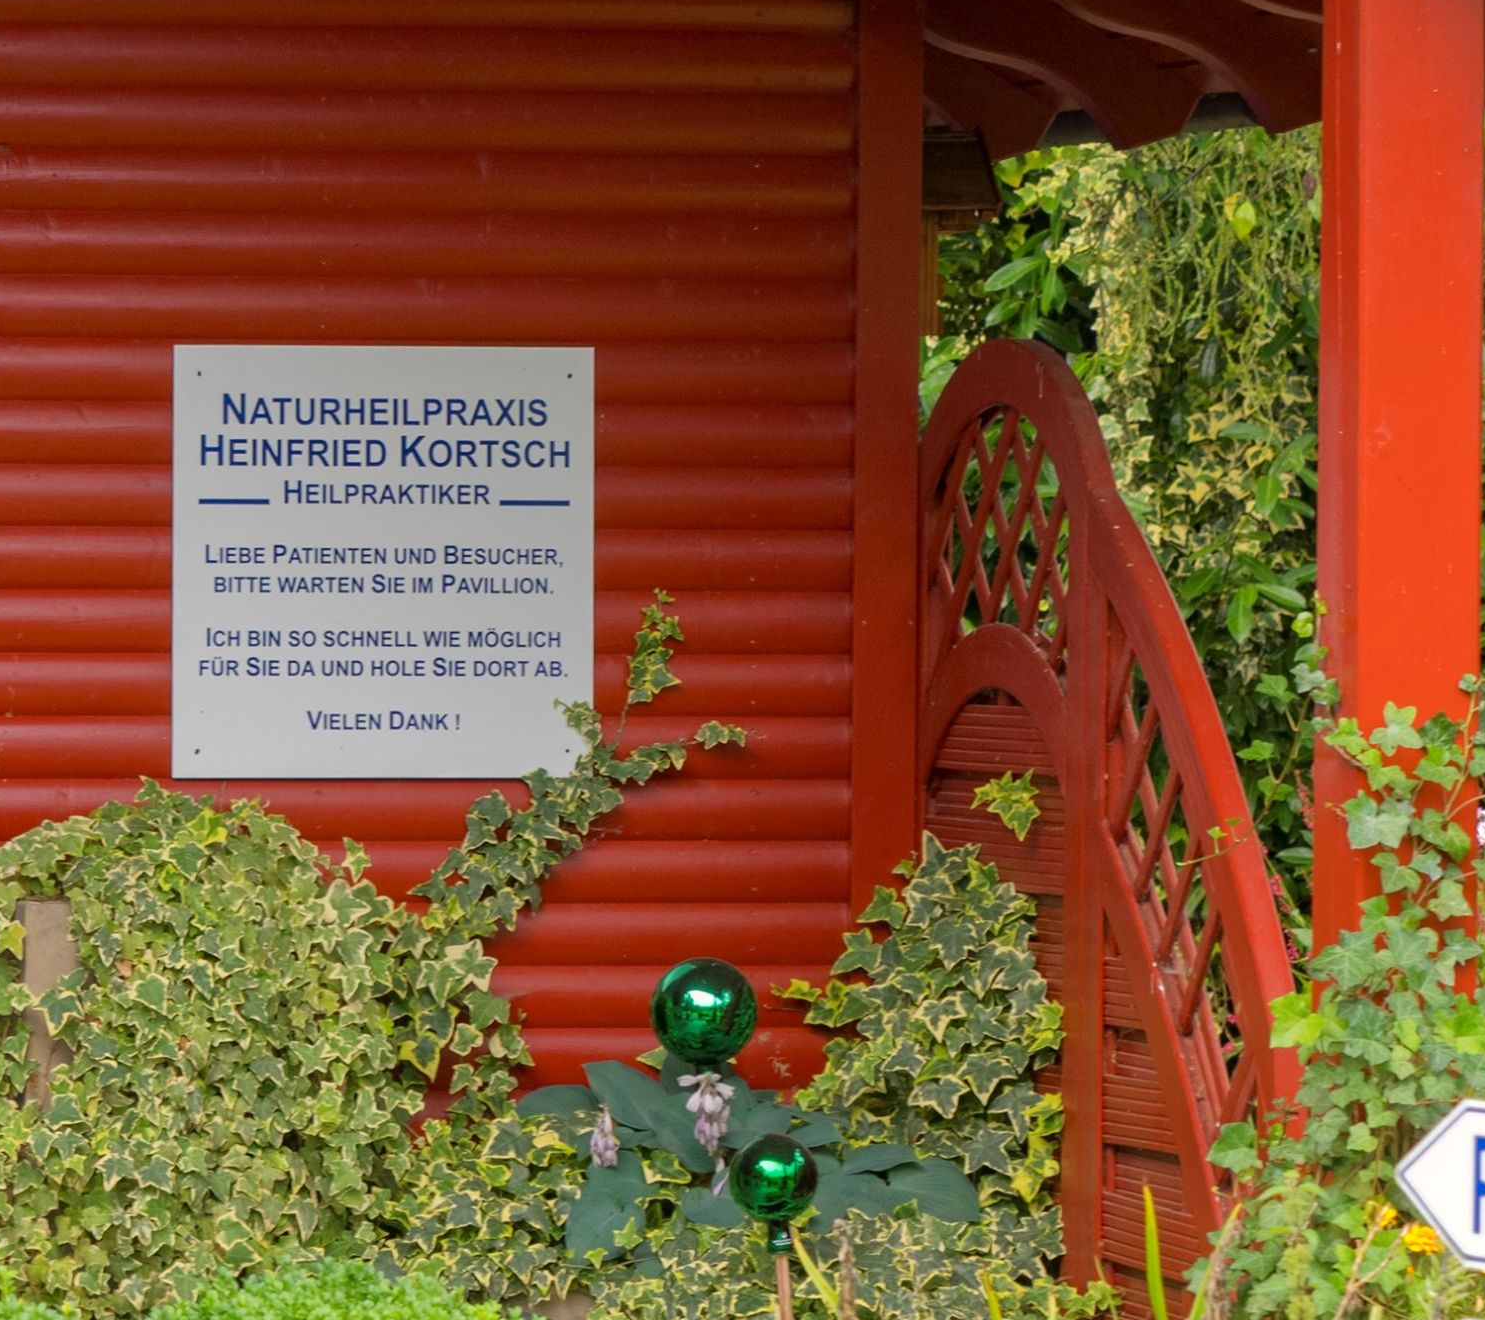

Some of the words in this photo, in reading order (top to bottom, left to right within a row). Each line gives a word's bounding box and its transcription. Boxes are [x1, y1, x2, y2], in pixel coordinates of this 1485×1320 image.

[222, 392, 548, 427] NATURHEILPRAXIS
[200, 433, 387, 468] HEINFRIED
[400, 434, 570, 469] KORTSCH
[283, 479, 491, 505] HEILPRAKTIKER
[205, 543, 266, 565] LIEBE
[273, 544, 387, 565] PATIENTEN
[394, 547, 437, 565] UND
[443, 544, 564, 568] BESUCHER,
[213, 576, 272, 594] BITTE
[277, 576, 365, 594] WARTEN
[371, 573, 406, 594] SIE
[412, 576, 434, 594] IM
[441, 573, 554, 595] PAVILLION.
[206, 627, 241, 648] ICH
[247, 630, 282, 648] BIN
[288, 630, 317, 648] SO
[322, 630, 419, 648] SCHNELL
[423, 630, 461, 648] WIE
[467, 627, 561, 648] MÖGLICH
[198, 656, 240, 677] FÜR
[246, 656, 281, 677] SIE
[287, 659, 316, 677] DA
[321, 659, 365, 677] UND
[370, 659, 426, 677] HOLE
[432, 656, 467, 677] SIE
[473, 660, 530, 678] DORT
[533, 660, 568, 678] AB.
[306, 710, 383, 731] VIELEN
[389, 710, 449, 731] DANK
[454, 713, 461, 731] !
